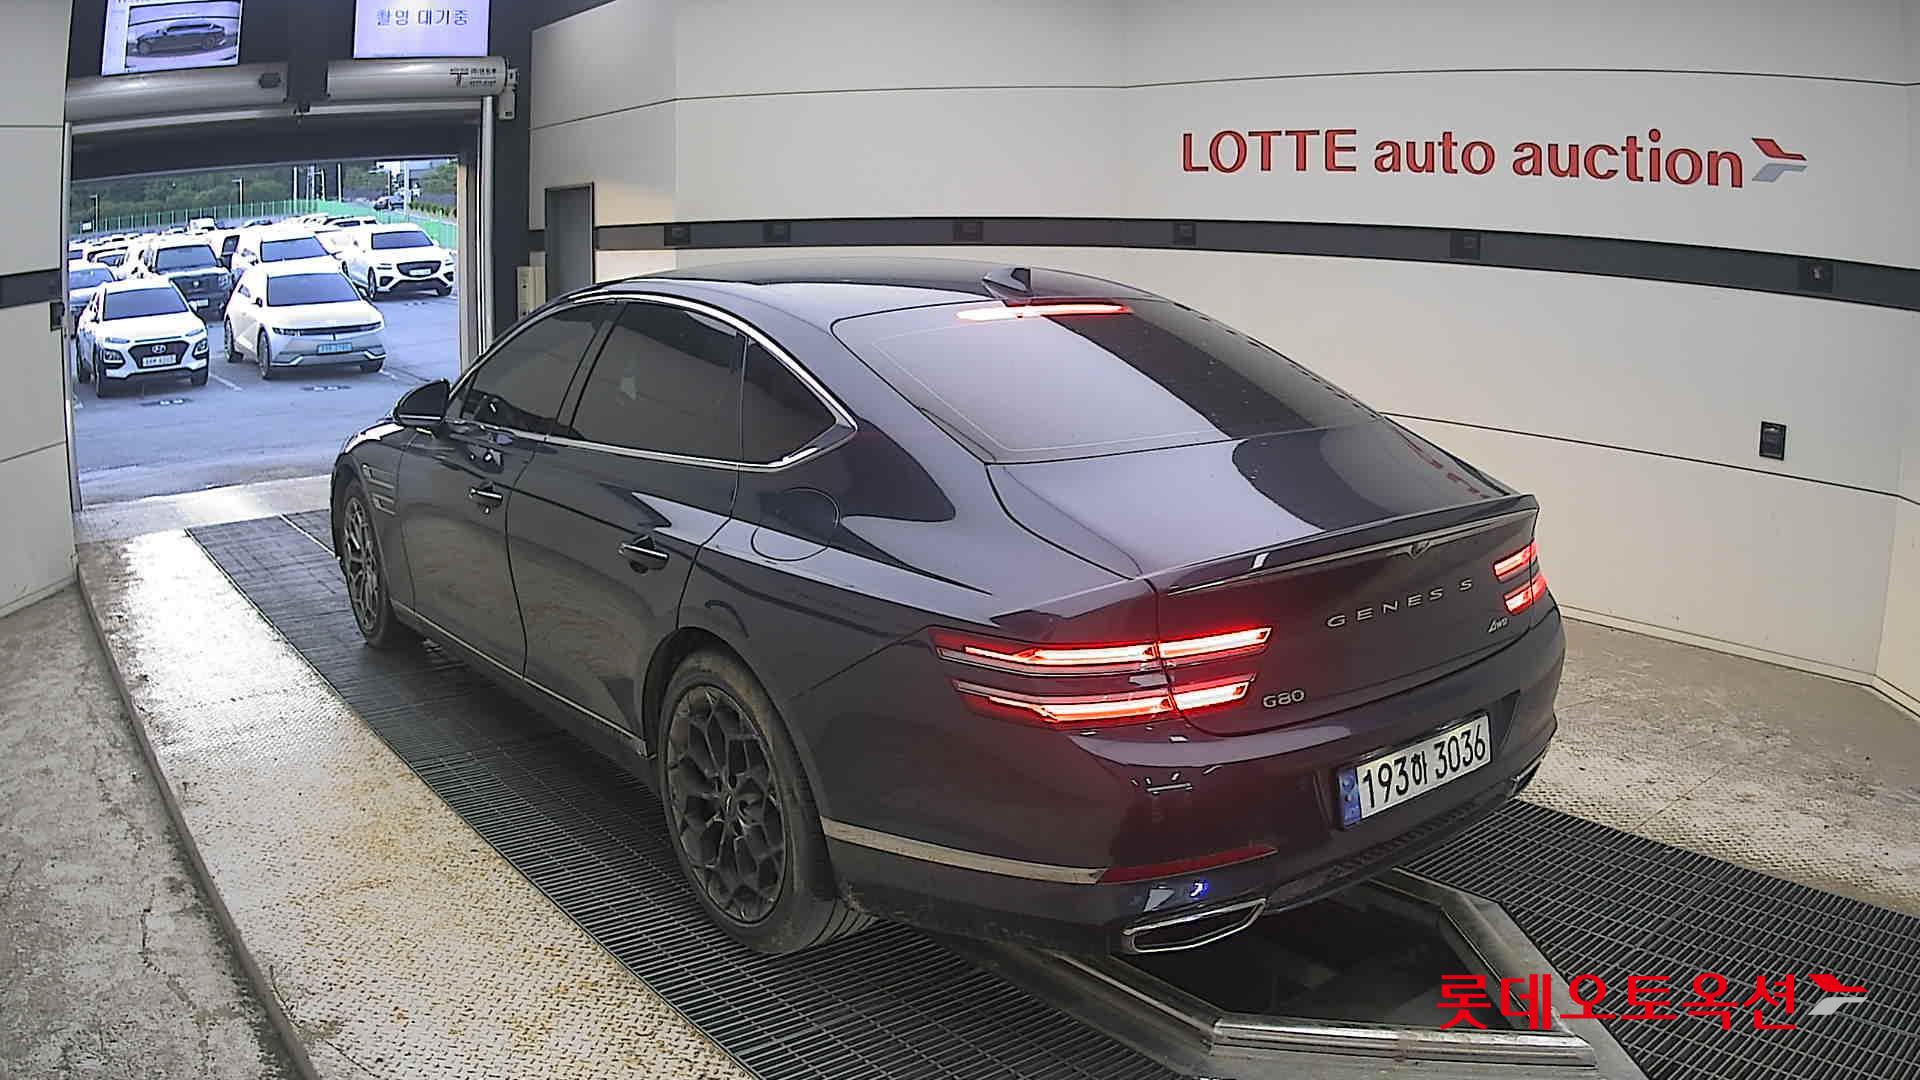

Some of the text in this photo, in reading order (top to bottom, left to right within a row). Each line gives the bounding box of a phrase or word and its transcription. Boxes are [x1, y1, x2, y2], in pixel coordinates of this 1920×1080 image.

[1182, 128, 1744, 188] LOTTE auto auction
[1326, 578, 1474, 628] GENESS
[1263, 689, 1305, 708] G80
[1362, 724, 1487, 809] 193하 3036
